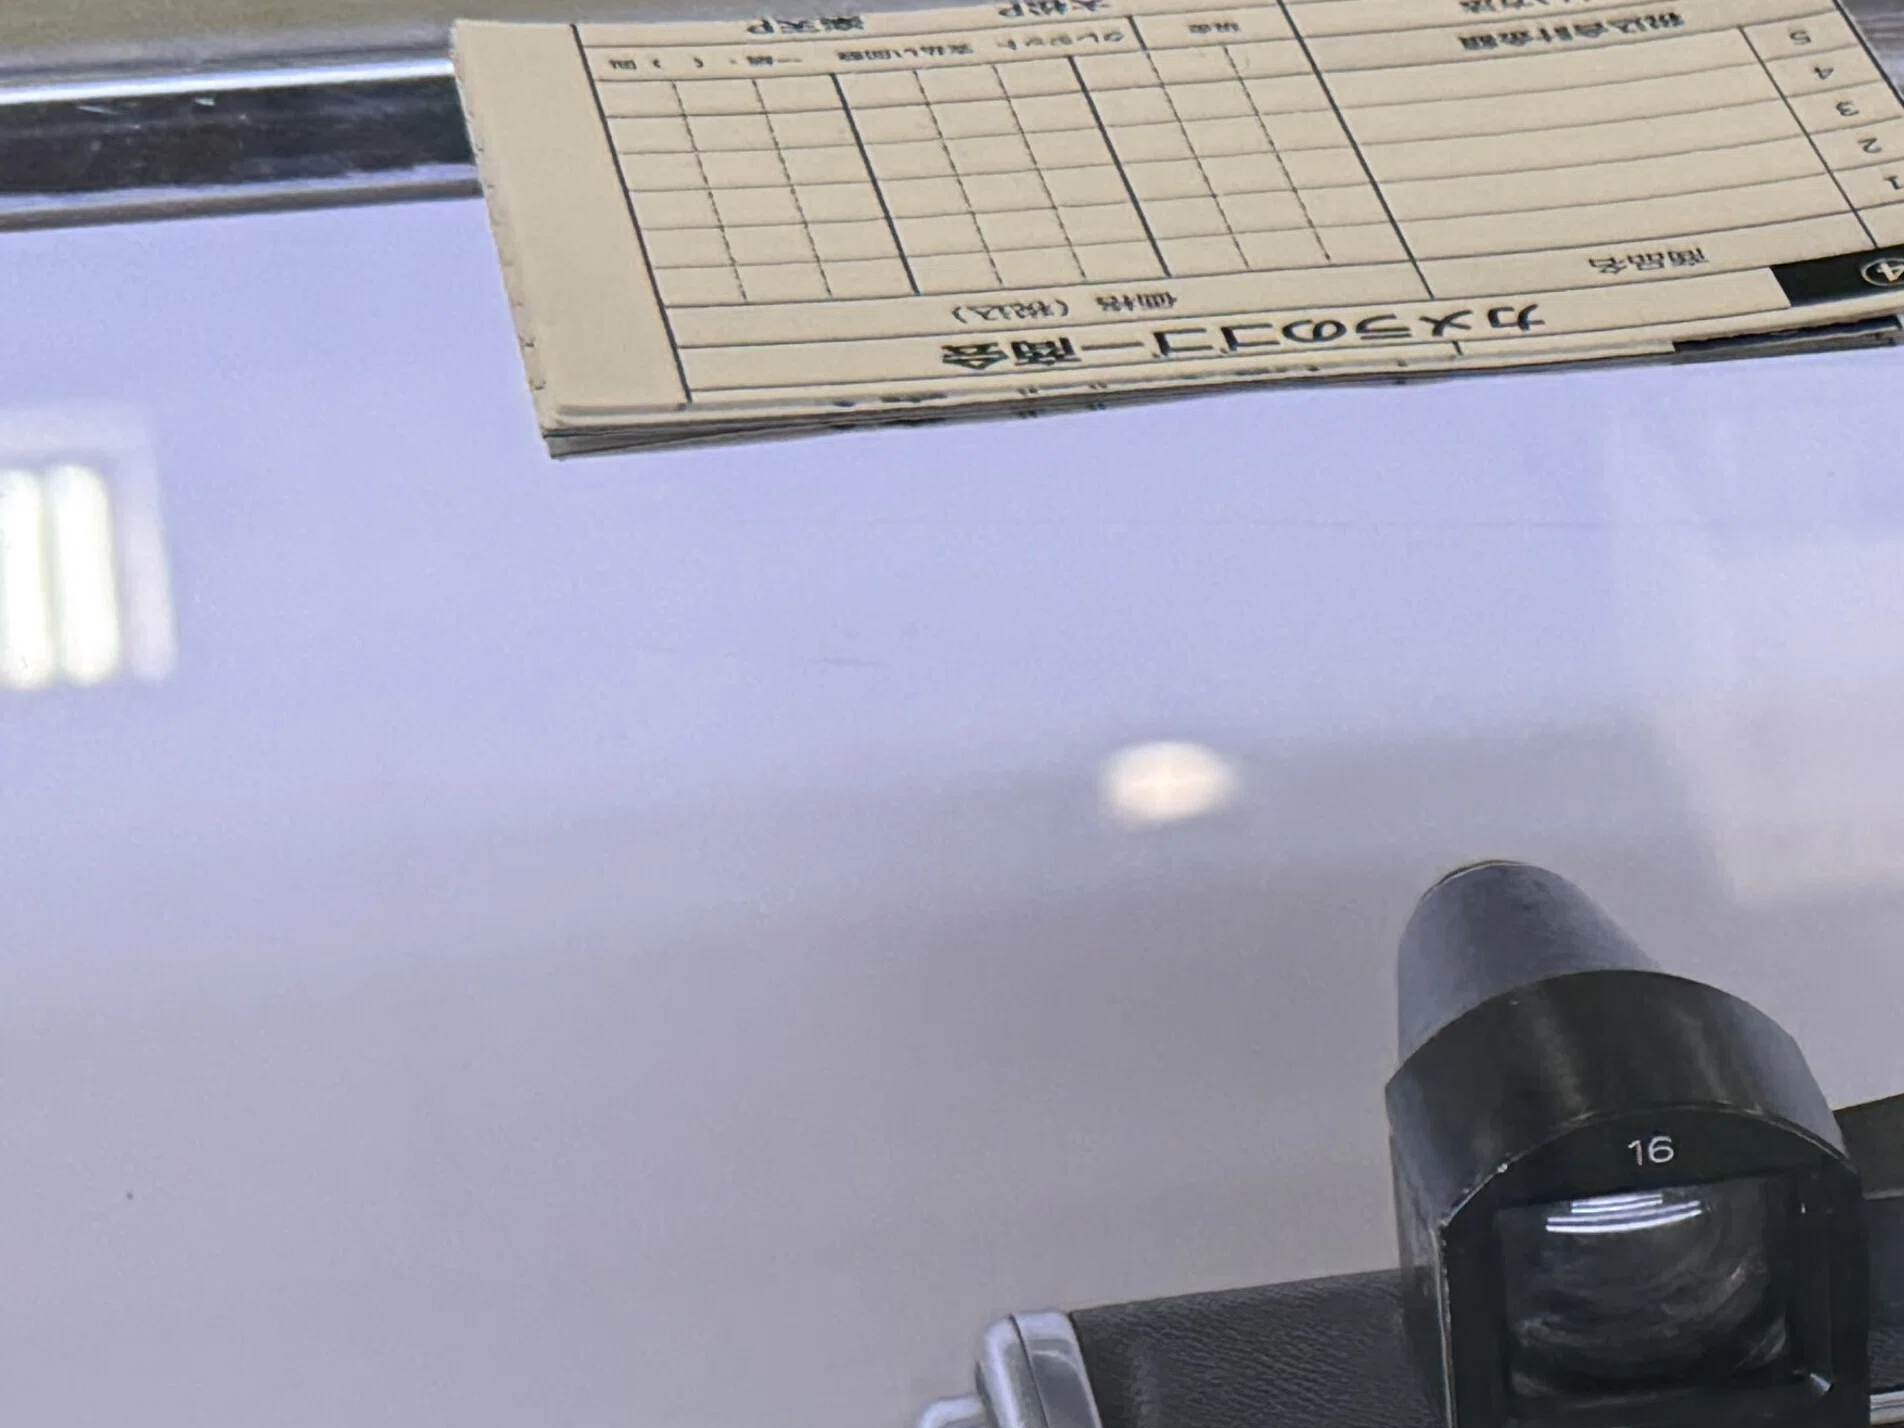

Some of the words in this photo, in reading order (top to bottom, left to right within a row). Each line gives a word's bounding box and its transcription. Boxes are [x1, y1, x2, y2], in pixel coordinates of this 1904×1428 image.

[1789, 29, 1812, 46] 5
[1813, 65, 1834, 81] 4
[1835, 100, 1860, 118] 3
[1857, 136, 1882, 154] 2
[1883, 174, 1904, 191] 1
[1588, 247, 1710, 276] 商品名
[941, 303, 1546, 370] カメラのゴゴー商会
[1628, 1136, 1675, 1166] 16
